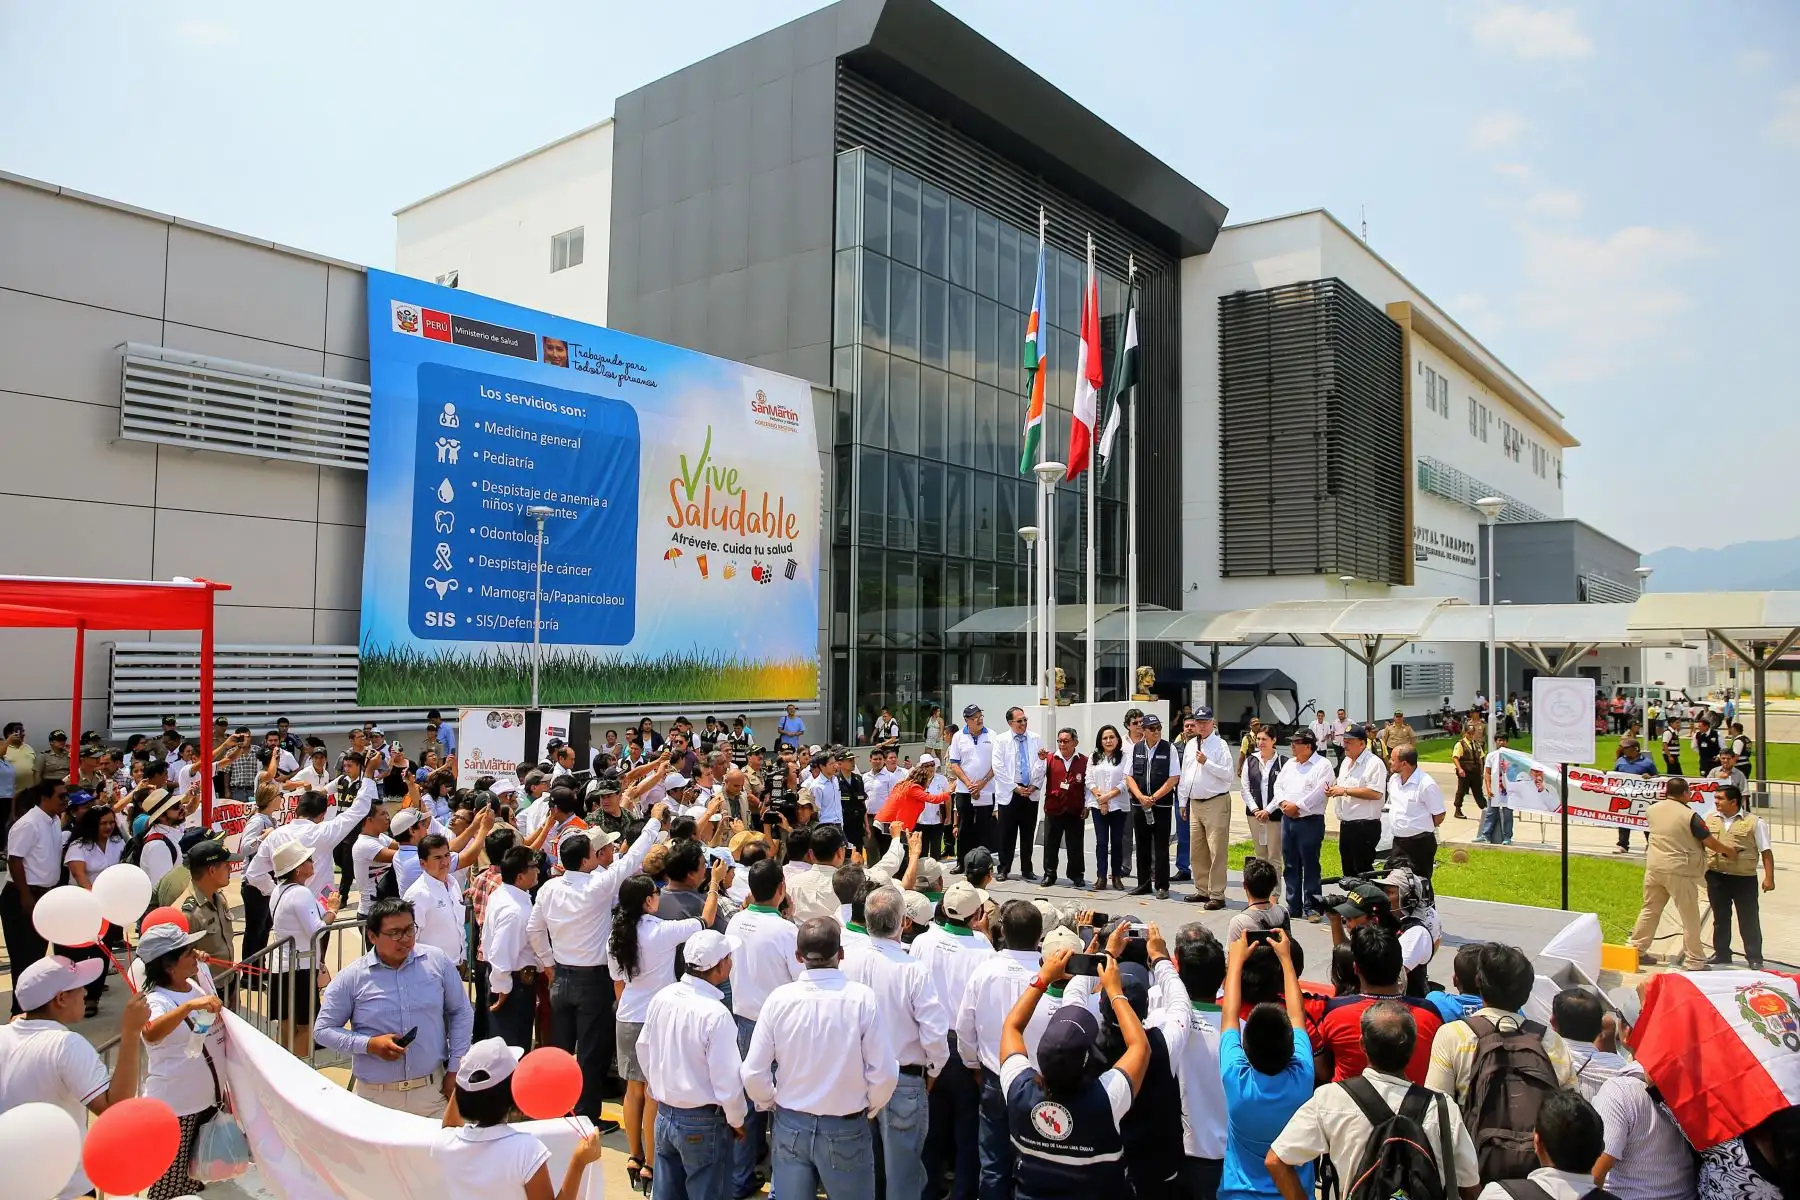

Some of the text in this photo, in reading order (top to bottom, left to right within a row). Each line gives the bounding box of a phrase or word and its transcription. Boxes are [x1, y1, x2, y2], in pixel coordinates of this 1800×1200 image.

[425, 319, 448, 332] PERÚ
[455, 326, 519, 347] Ministerio de Salud
[569, 343, 648, 375] Trabajando para
[480, 385, 587, 418] Los servicios son:
[484, 421, 581, 449] Medicina general
[483, 450, 534, 470] Pediatría
[680, 424, 742, 502] Vive
[482, 479, 609, 508] Despistaje de anemia a
[482, 497, 514, 512] niños
[516, 504, 524, 516] y
[666, 478, 800, 540] Saludable
[671, 531, 793, 556] Atrévete. Cuida tu salud
[1440, 533, 1475, 555] TARAPOTO
[478, 554, 592, 577] Despistaje de cáncer
[424, 611, 456, 627] SIS
[464, 758, 516, 771] SanMartín
[1568, 770, 1604, 785] SAN
[1597, 812, 1635, 825] MARTÍN
